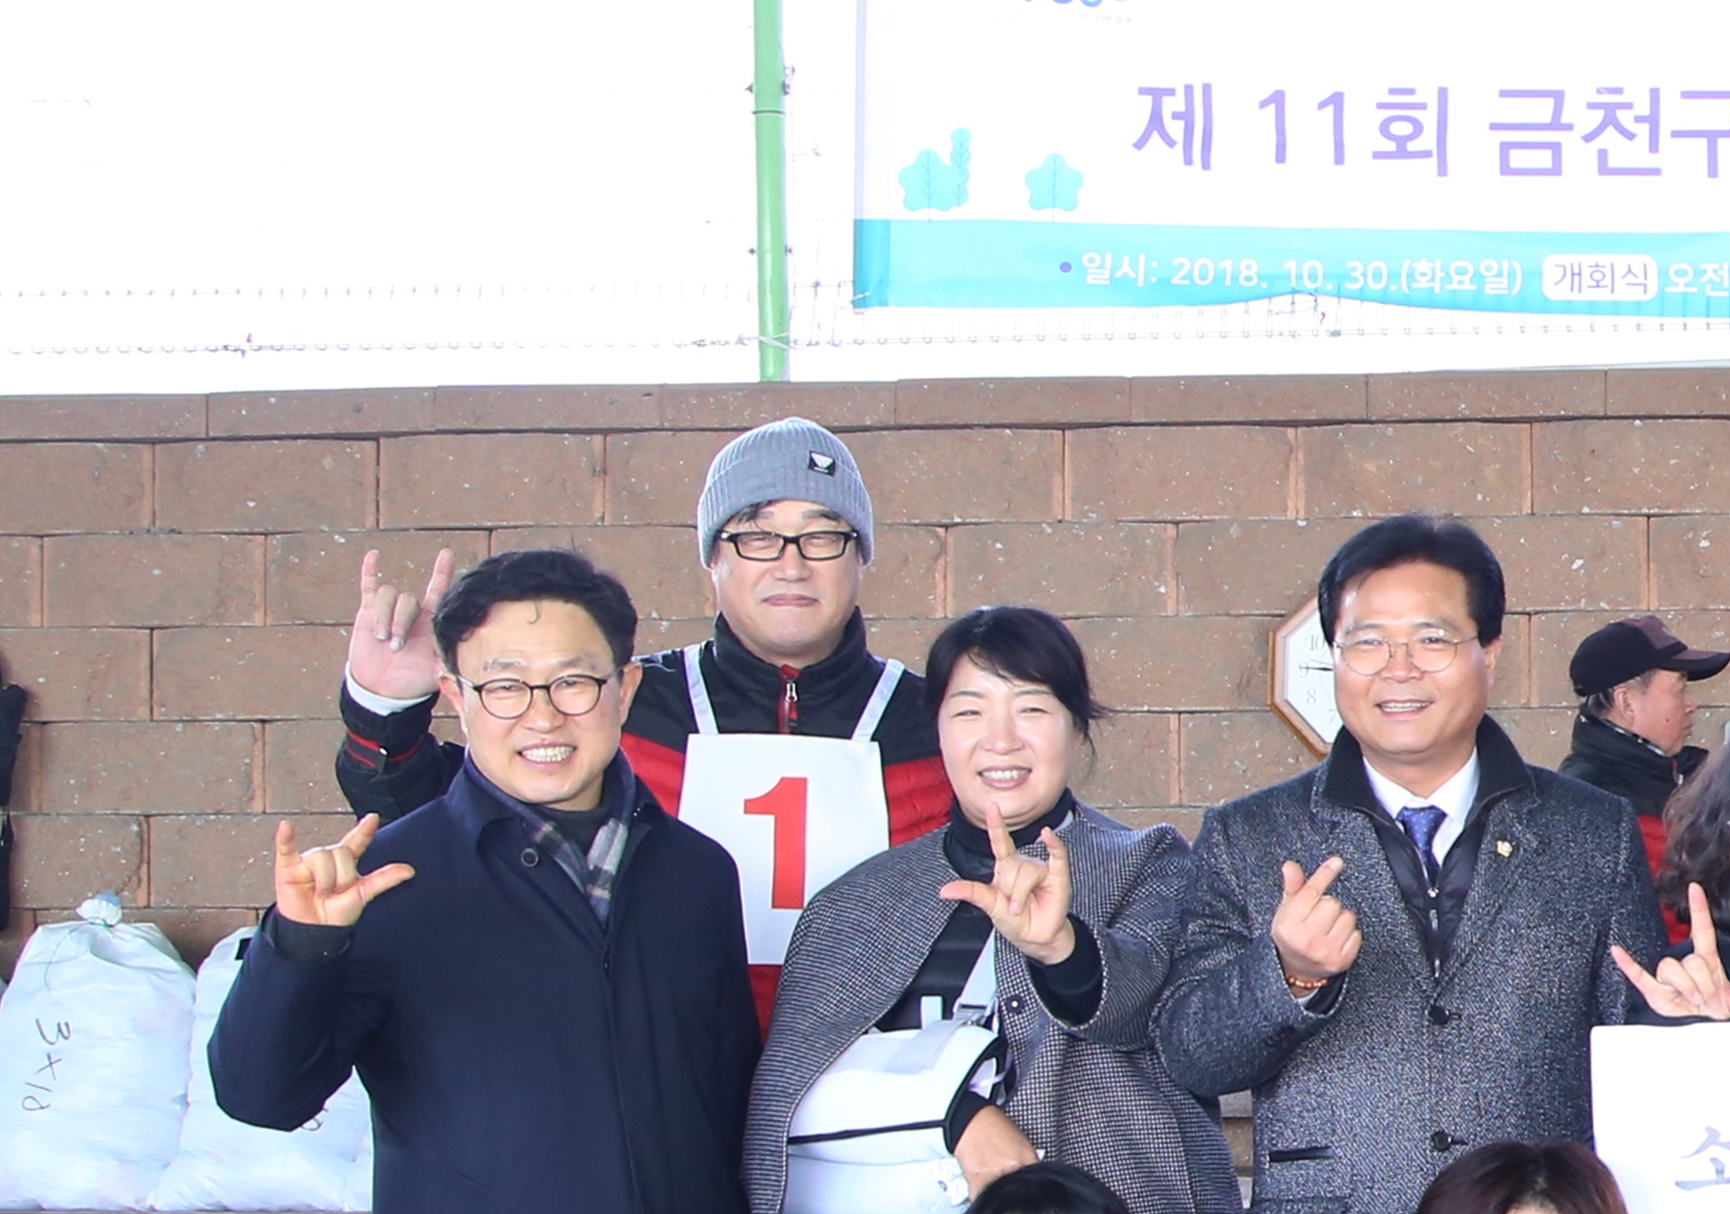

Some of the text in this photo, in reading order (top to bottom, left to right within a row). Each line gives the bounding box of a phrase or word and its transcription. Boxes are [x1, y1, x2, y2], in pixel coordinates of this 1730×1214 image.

[1132, 82, 1213, 171] 제
[1259, 86, 1449, 178] 11회
[1081, 252, 1159, 288] 일시:
[1170, 256, 1269, 290] 2018.
[1282, 258, 1334, 292] 10.
[1553, 261, 1649, 296] 개회식
[1306, 687, 1317, 706] 8
[743, 777, 808, 910] 1
